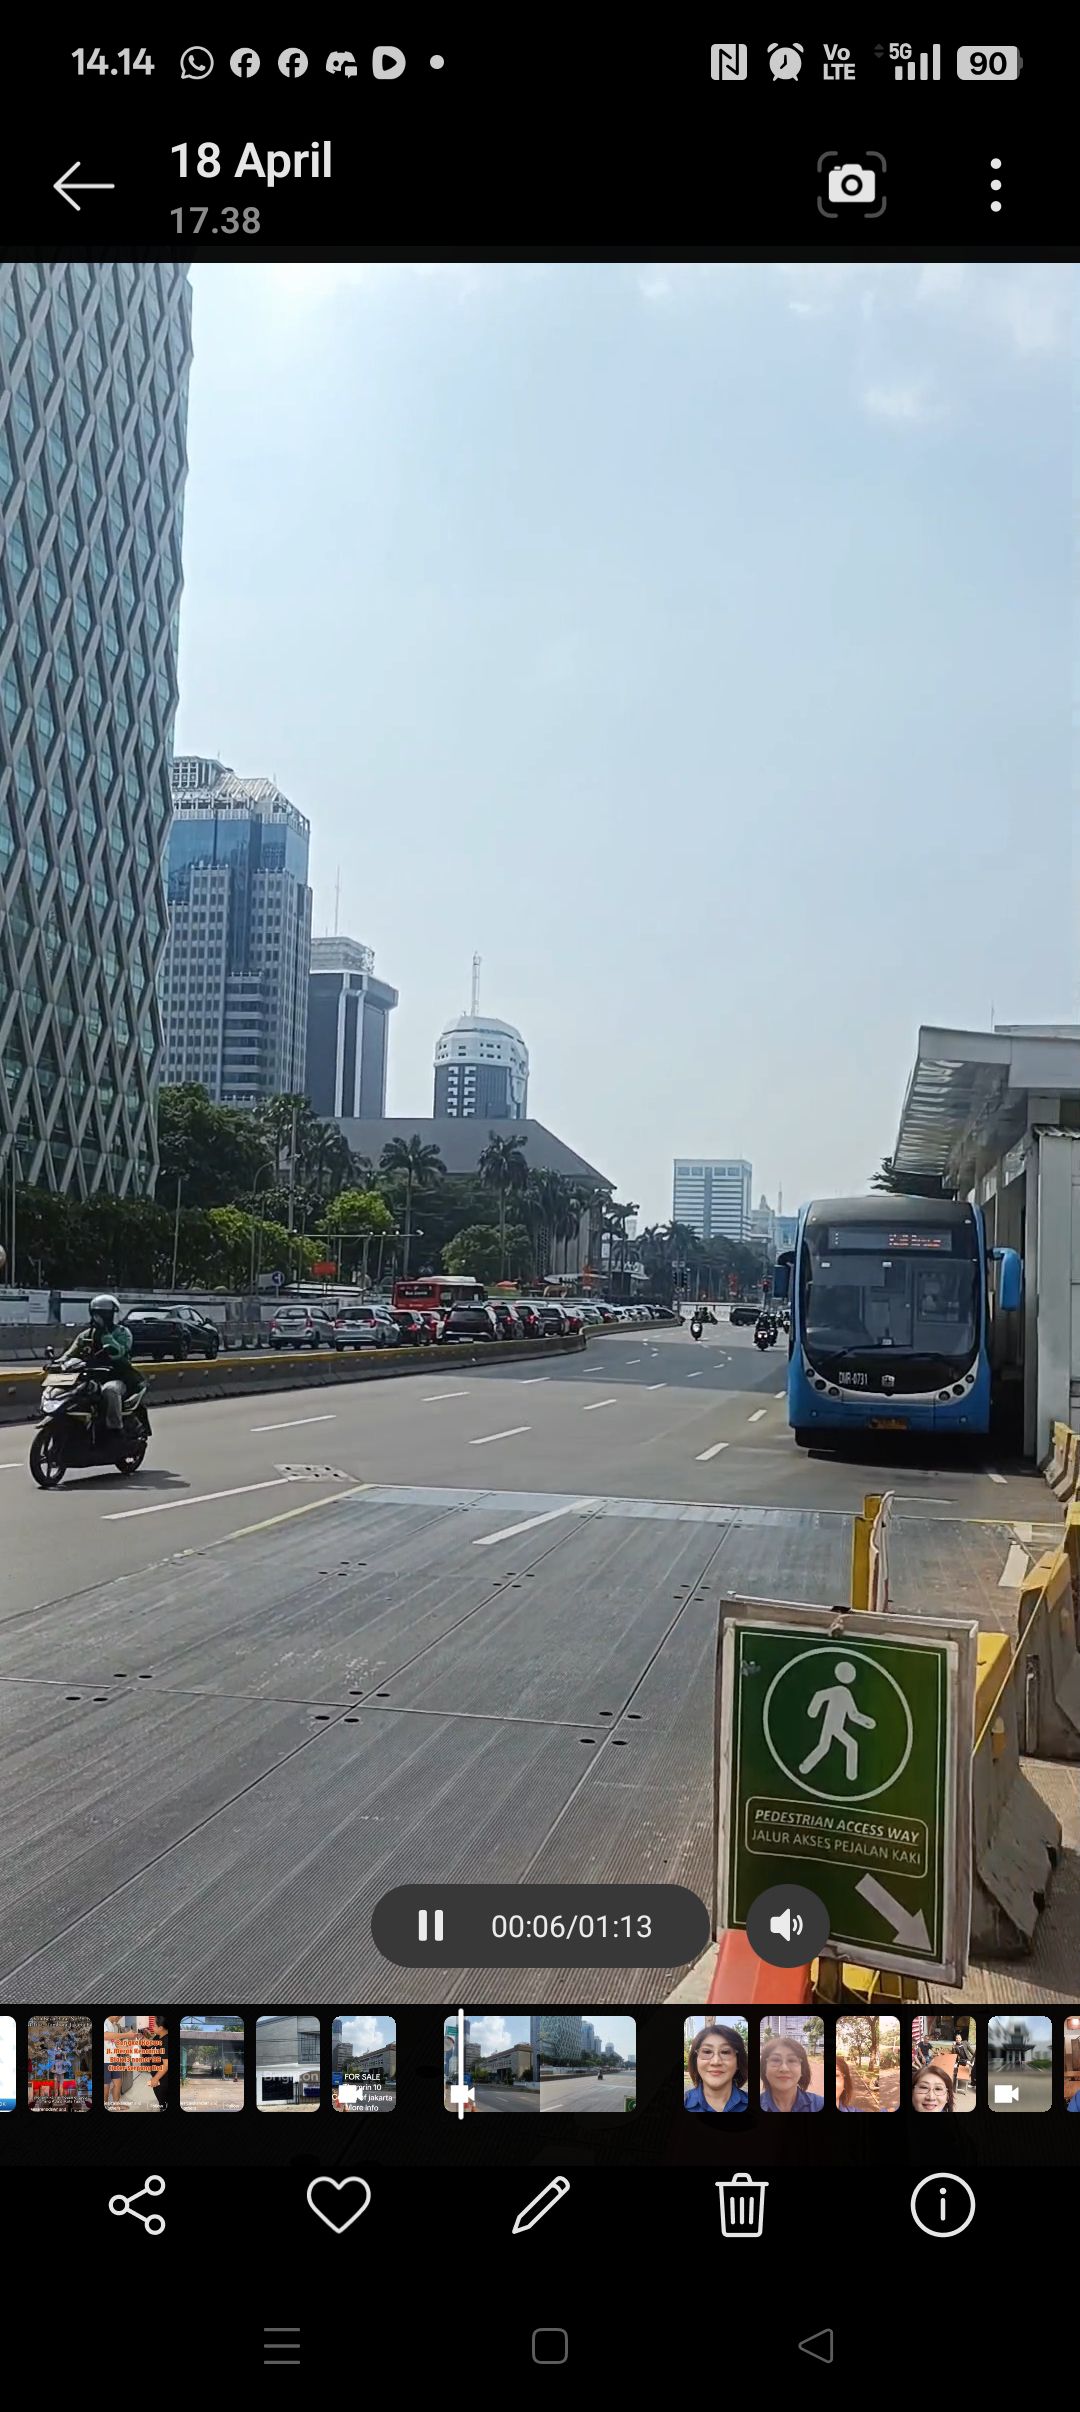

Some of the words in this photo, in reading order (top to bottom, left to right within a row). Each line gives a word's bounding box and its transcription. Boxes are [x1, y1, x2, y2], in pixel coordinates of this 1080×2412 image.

[754, 1808, 834, 1831] PEDESTRIAN
[836, 1818, 884, 1838] ACCESS
[887, 1825, 920, 1843] WAY
[751, 1828, 790, 1844] JALUR
[792, 1833, 831, 1850] AKSES
[834, 1838, 889, 1860] PEJALAN
[891, 1846, 922, 1866] KAKI
